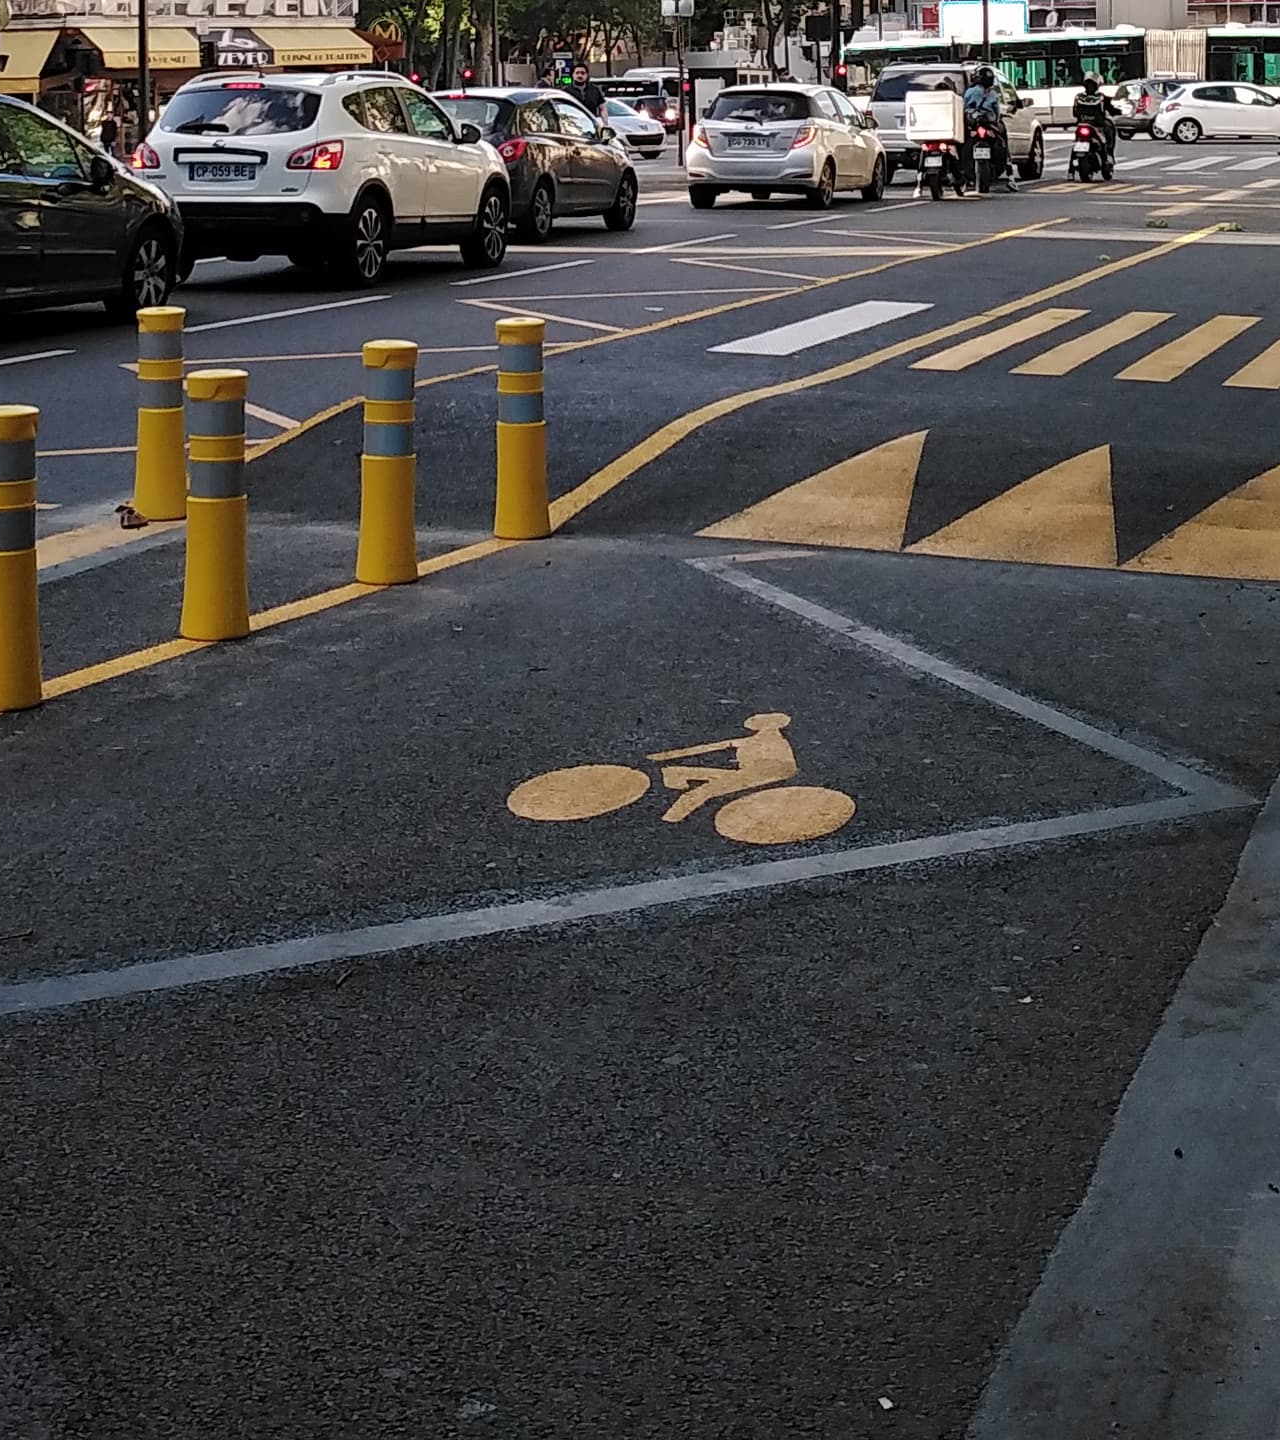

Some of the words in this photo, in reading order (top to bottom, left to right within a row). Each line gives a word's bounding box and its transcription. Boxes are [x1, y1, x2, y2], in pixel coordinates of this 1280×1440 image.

[218, 52, 269, 65] ZEYER
[196, 165, 248, 178] CP-059-BE
[1026, 182, 1209, 195] BUS
